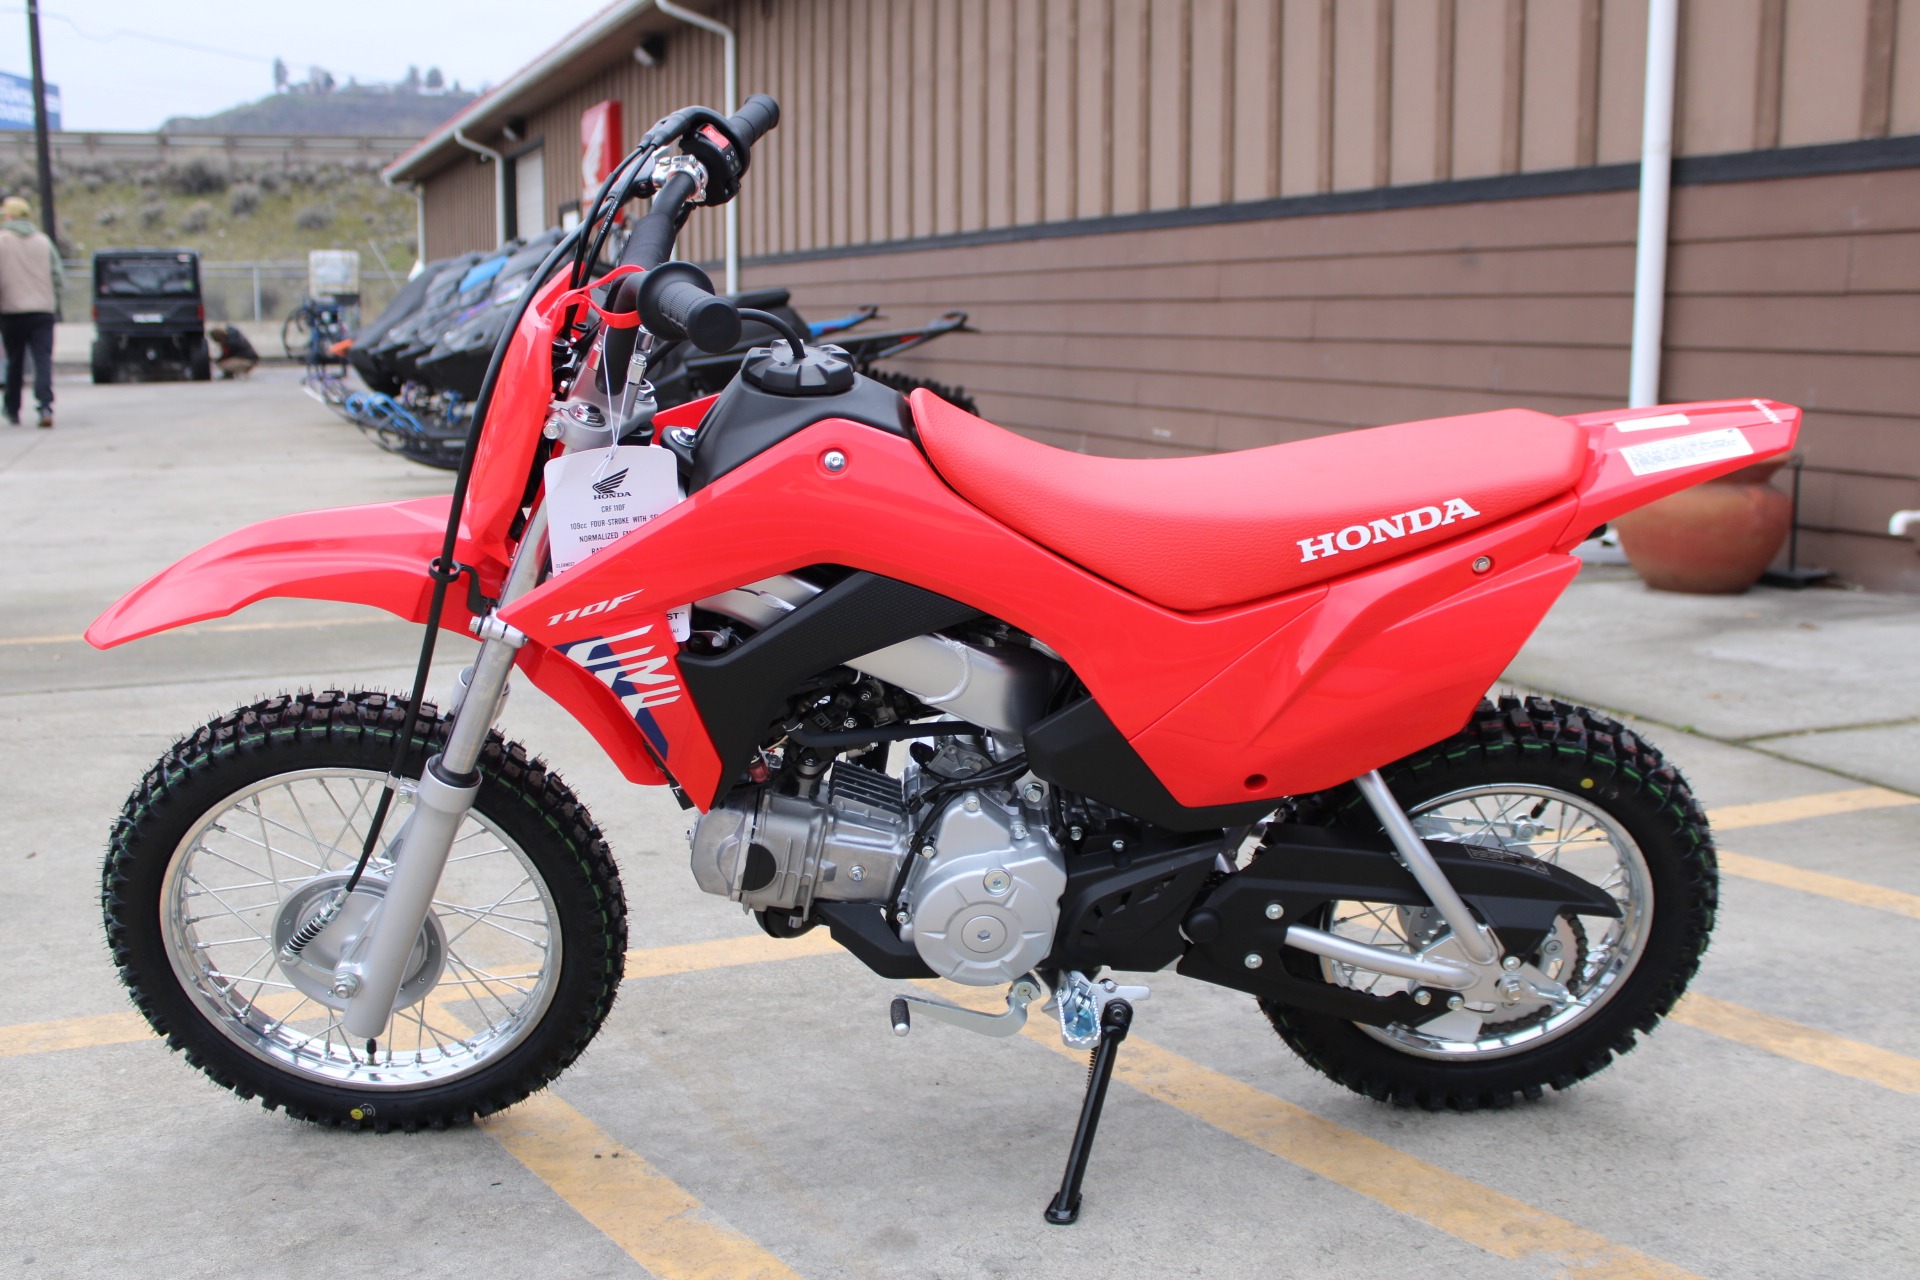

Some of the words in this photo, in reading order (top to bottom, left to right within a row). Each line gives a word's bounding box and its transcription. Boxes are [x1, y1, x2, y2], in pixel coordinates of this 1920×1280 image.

[593, 492, 632, 500] HONDA
[601, 505, 612, 513] CRF
[613, 504, 626, 512] 110F
[570, 522, 587, 530] 109cc
[590, 517, 629, 528] FOUR-STROKE
[632, 515, 647, 523] WITH
[1296, 497, 1480, 563] HONDA
[579, 532, 619, 543] NORMALIZED
[547, 589, 645, 626] 110F
[566, 624, 682, 719] CRF
